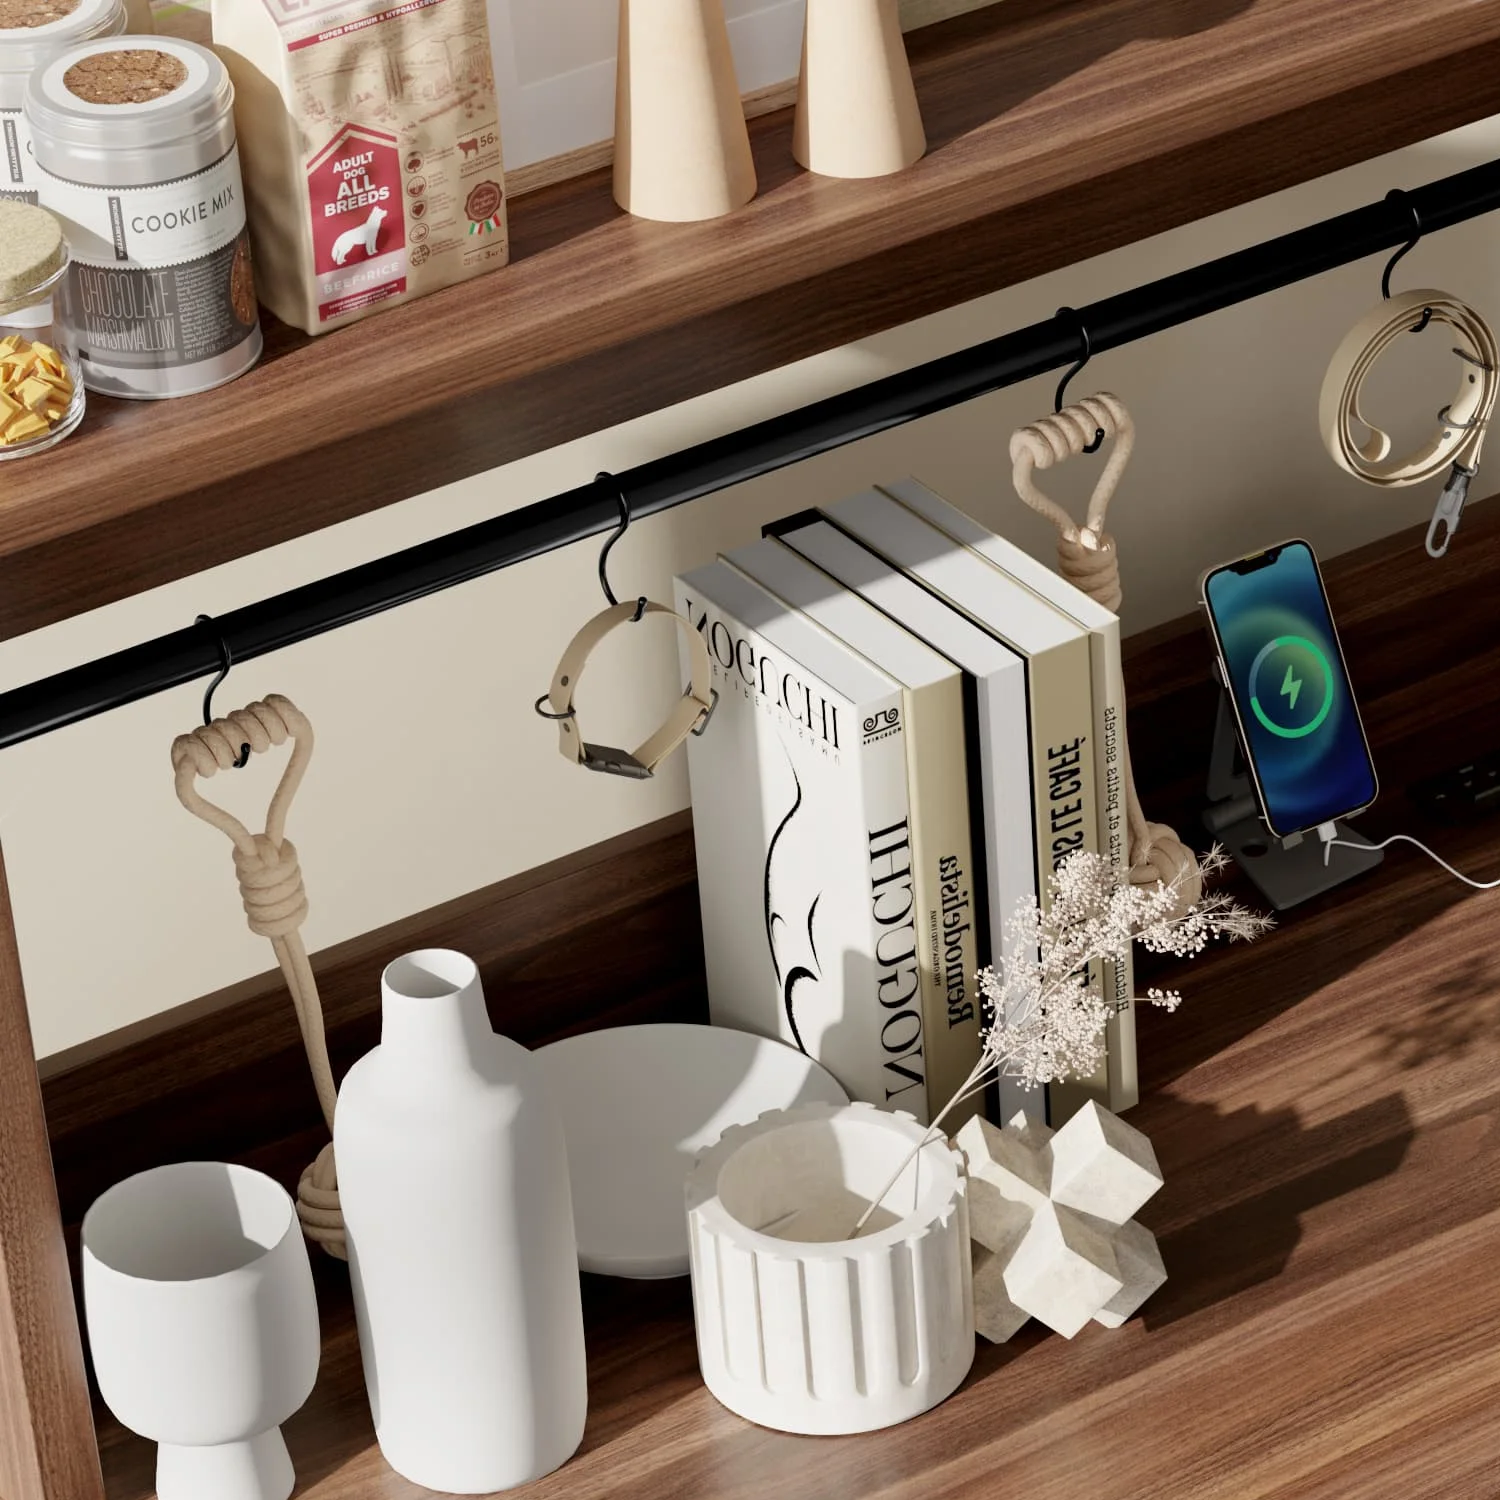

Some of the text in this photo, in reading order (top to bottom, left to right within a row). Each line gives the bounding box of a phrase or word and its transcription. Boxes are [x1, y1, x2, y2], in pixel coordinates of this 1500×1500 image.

[318, 29, 343, 41] SUPER
[344, 17, 378, 33] PREMIUM
[333, 151, 374, 174] ADULT
[343, 167, 366, 180] DOG
[324, 186, 390, 217] BREEDS
[336, 175, 376, 200] ALL
[131, 201, 208, 234] COOKIE
[212, 185, 234, 215] MIX
[78, 267, 174, 319] CHOCOLATE
[85, 313, 176, 351] MARSHMALLOW
